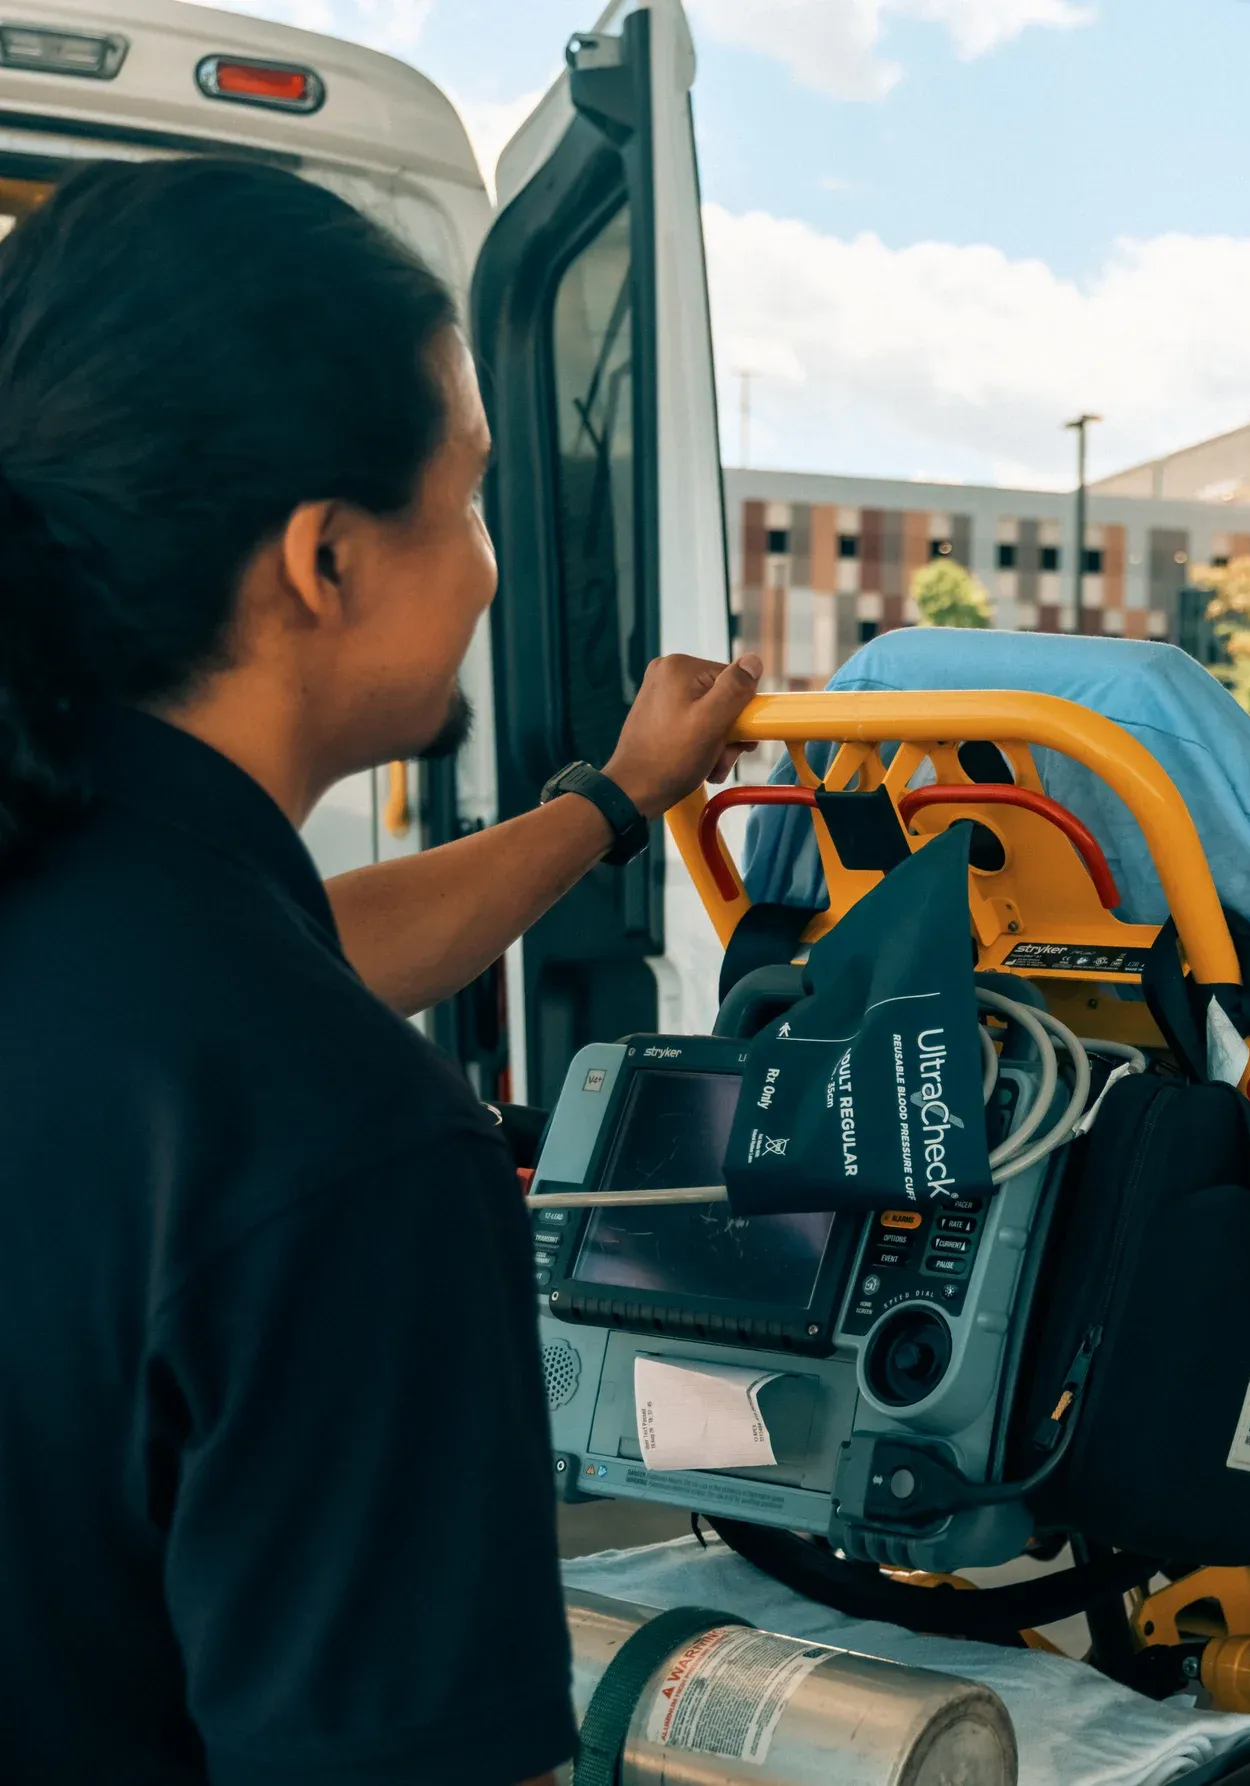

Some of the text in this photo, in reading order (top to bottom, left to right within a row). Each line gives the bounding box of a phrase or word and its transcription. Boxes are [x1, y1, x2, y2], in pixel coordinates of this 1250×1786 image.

[1013, 944, 1068, 955] stryker
[643, 1045, 683, 1059] stryker
[893, 1034, 906, 1084] REUSABLE
[757, 1068, 781, 1110] Rx Only
[897, 1085, 908, 1121] BLOOD
[838, 1048, 858, 1177] DULT REGULAR
[900, 1122, 913, 1174] PRESSURE
[954, 1200, 973, 1209] PACER
[891, 1214, 915, 1224] ALARMS
[948, 1220, 963, 1229] RATE
[883, 1234, 908, 1244] OPTIONS
[881, 1254, 899, 1263] EVENT
[935, 1260, 955, 1269] PAUSE
[915, 1290, 935, 1298] DIAL
